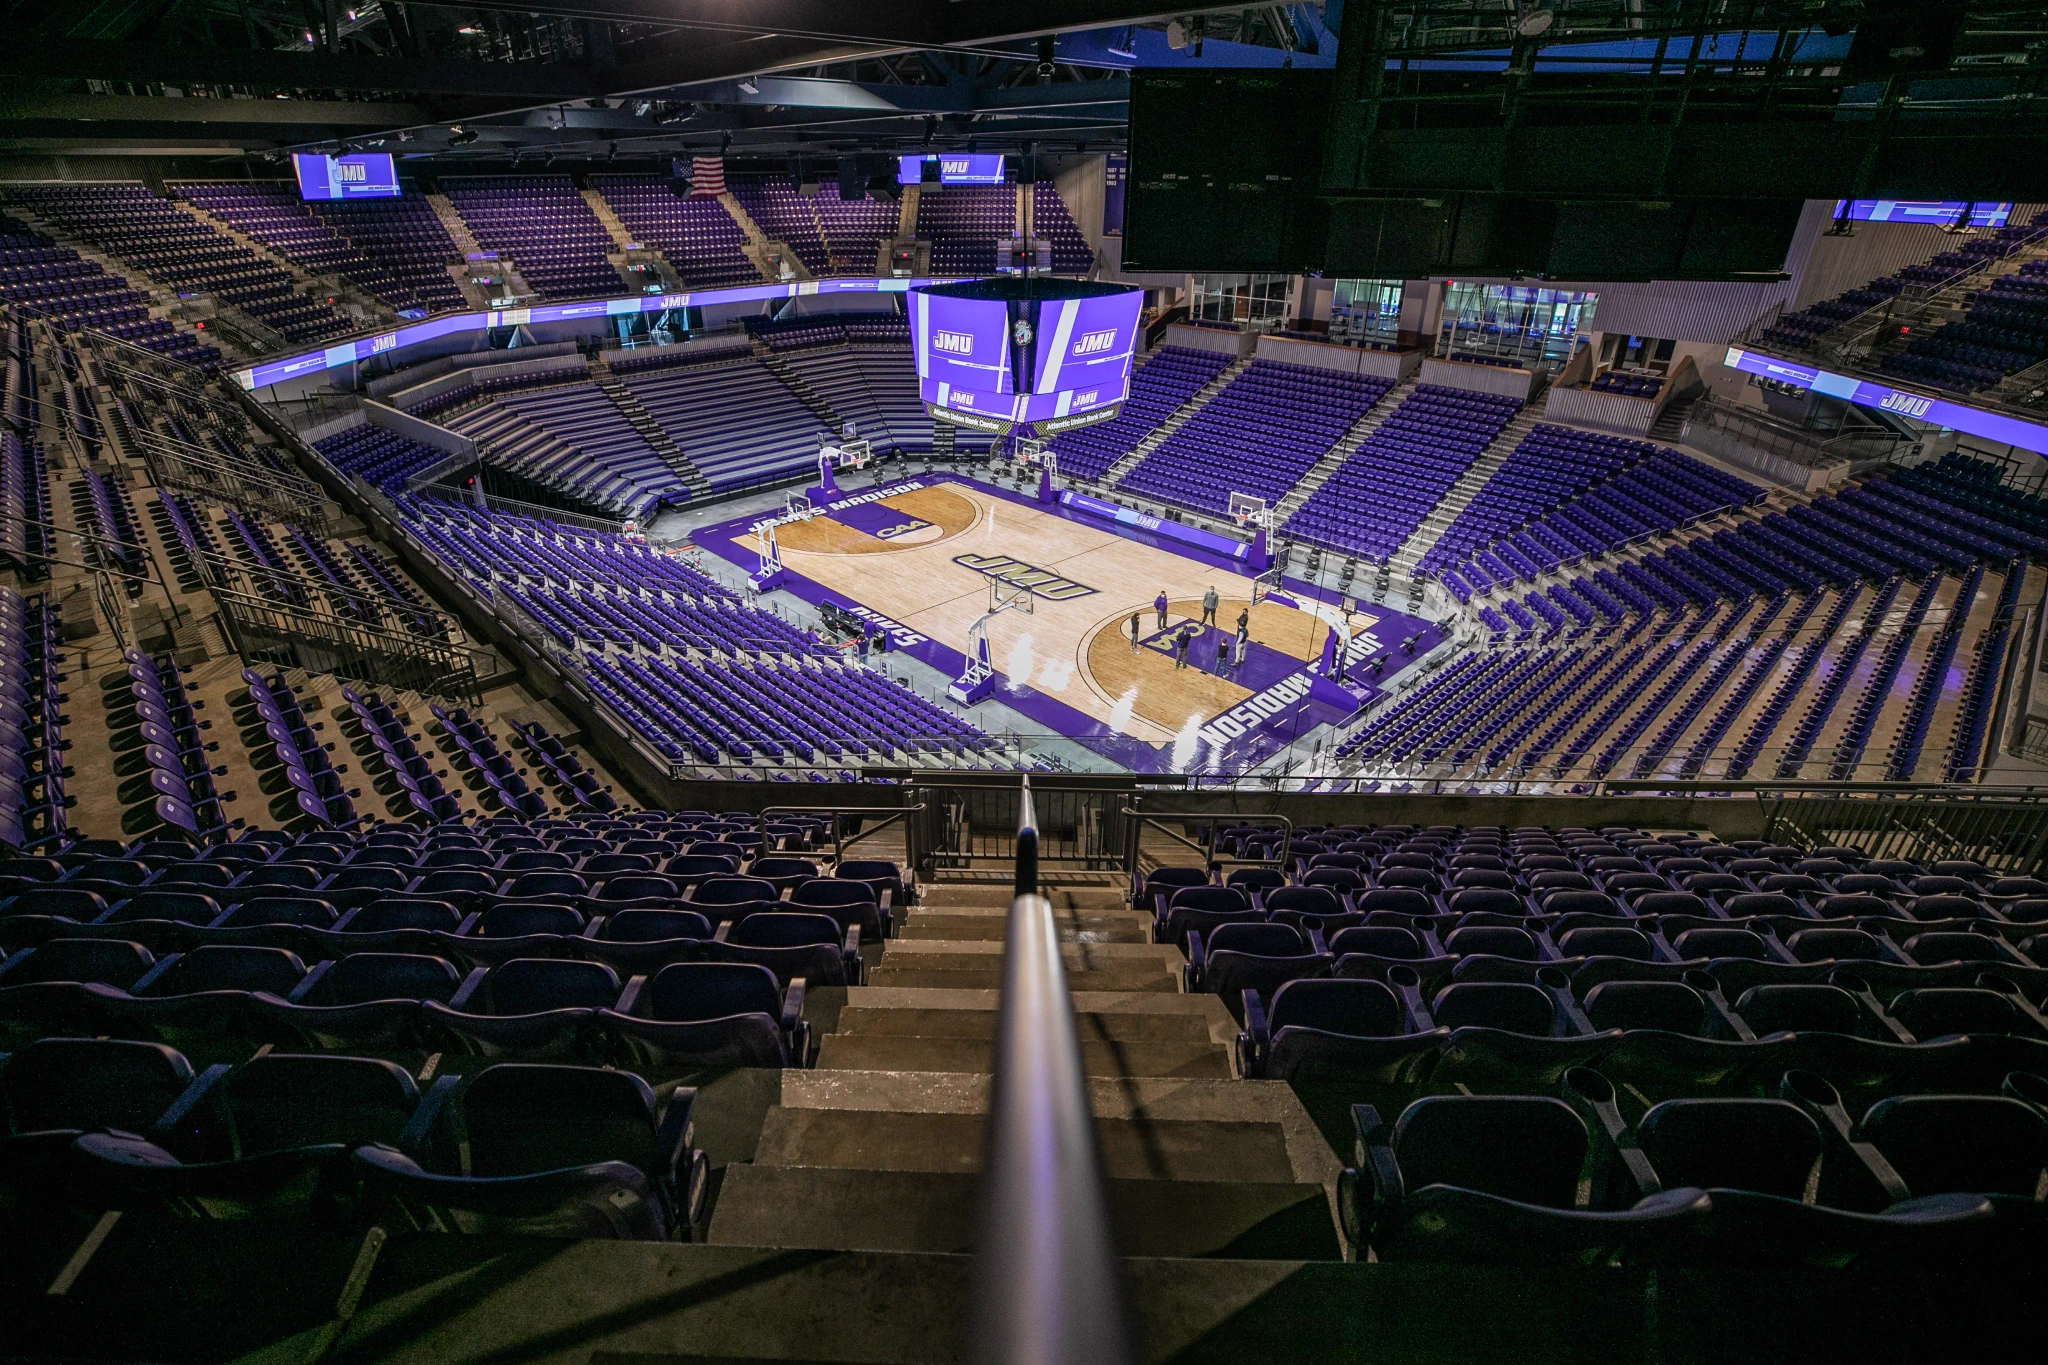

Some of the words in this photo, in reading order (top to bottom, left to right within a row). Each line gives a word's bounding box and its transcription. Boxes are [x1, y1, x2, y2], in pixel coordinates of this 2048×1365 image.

[333, 163, 366, 183] JMU
[941, 160, 969, 174] MU
[660, 296, 690, 307] JMU
[371, 333, 396, 353] JMU
[933, 330, 973, 355] JMU
[1073, 329, 1117, 355] JMU
[950, 391, 974, 406] JMU
[1072, 390, 1098, 408] JMU
[1880, 390, 1934, 418] JMU
[1046, 420, 1071, 430] Atlantic
[1070, 417, 1087, 425] Union
[1086, 414, 1099, 422] Bank
[828, 482, 924, 511] MADISON
[876, 520, 930, 538] CAA
[1136, 515, 1162, 530] JMU
[953, 554, 1099, 601] JMU
[1199, 671, 1314, 748] MADISON
